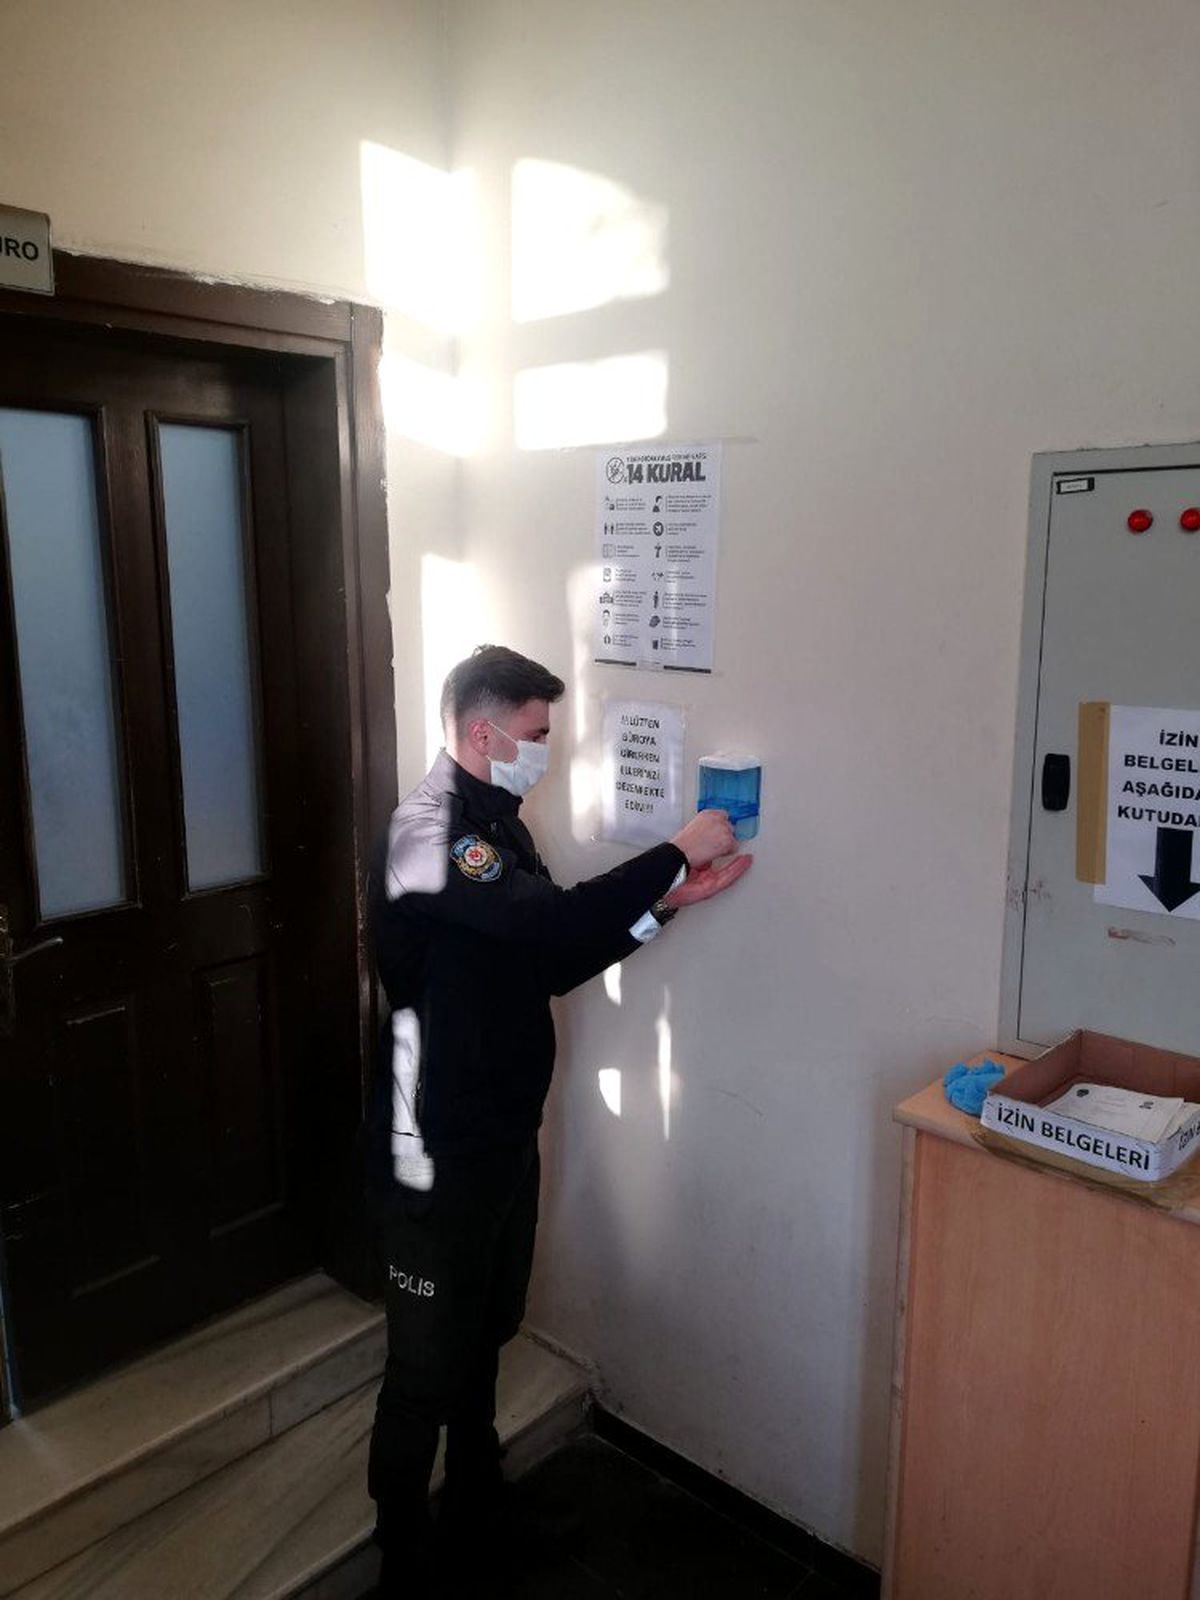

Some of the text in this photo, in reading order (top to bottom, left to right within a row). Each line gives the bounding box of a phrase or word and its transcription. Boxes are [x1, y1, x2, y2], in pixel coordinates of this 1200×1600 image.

[0, 236, 39, 261] RO
[626, 461, 706, 484] 14 KURAL
[1159, 729, 1199, 748] İZİN
[1118, 805, 1200, 828] KUTUDA
[998, 1102, 1035, 1133] İZİN
[1041, 1120, 1150, 1171] BELGELERİ
